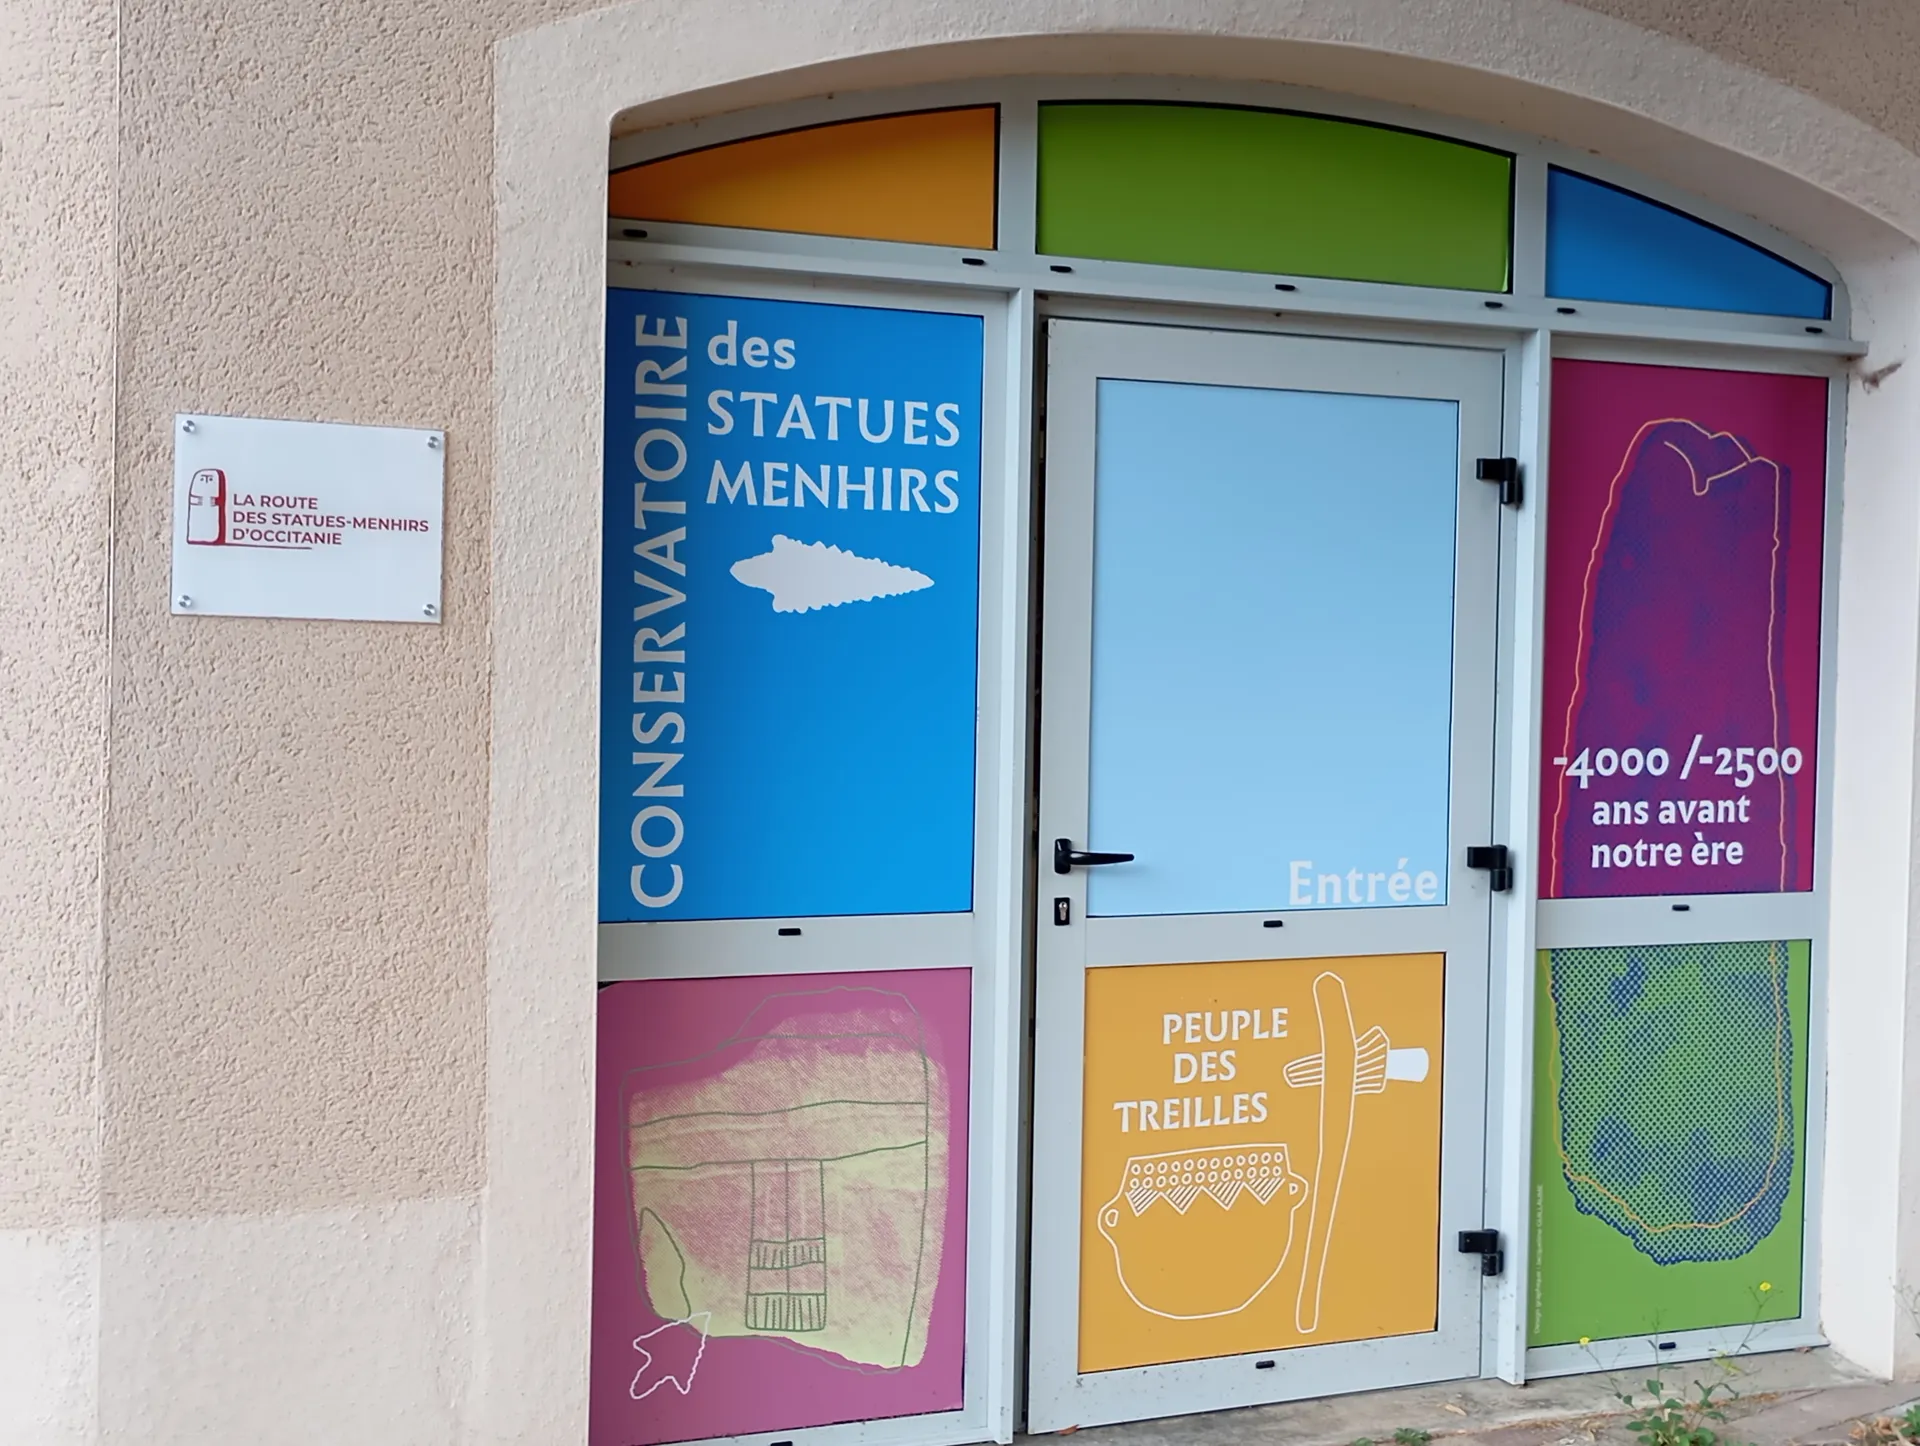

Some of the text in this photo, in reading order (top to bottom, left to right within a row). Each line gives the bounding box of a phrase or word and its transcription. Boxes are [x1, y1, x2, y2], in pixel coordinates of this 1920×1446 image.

[707, 319, 796, 370] des
[707, 389, 961, 448] STATUES
[233, 493, 318, 510] LA ROUTE
[706, 459, 961, 514] MENHIRS
[232, 511, 429, 532] DES STATUES-MENHIRS
[232, 528, 342, 545] D'OCCITANIE
[630, 314, 688, 908] CONSERVATOIRE
[1553, 747, 1670, 789] -4000
[1592, 795, 1750, 825] ans avant
[1591, 832, 1743, 868] notre ère
[1289, 858, 1439, 906] Entrée
[1162, 1008, 1289, 1044] PEUPLE
[1173, 1050, 1237, 1084] DES
[1113, 1092, 1269, 1132] TREILLES
